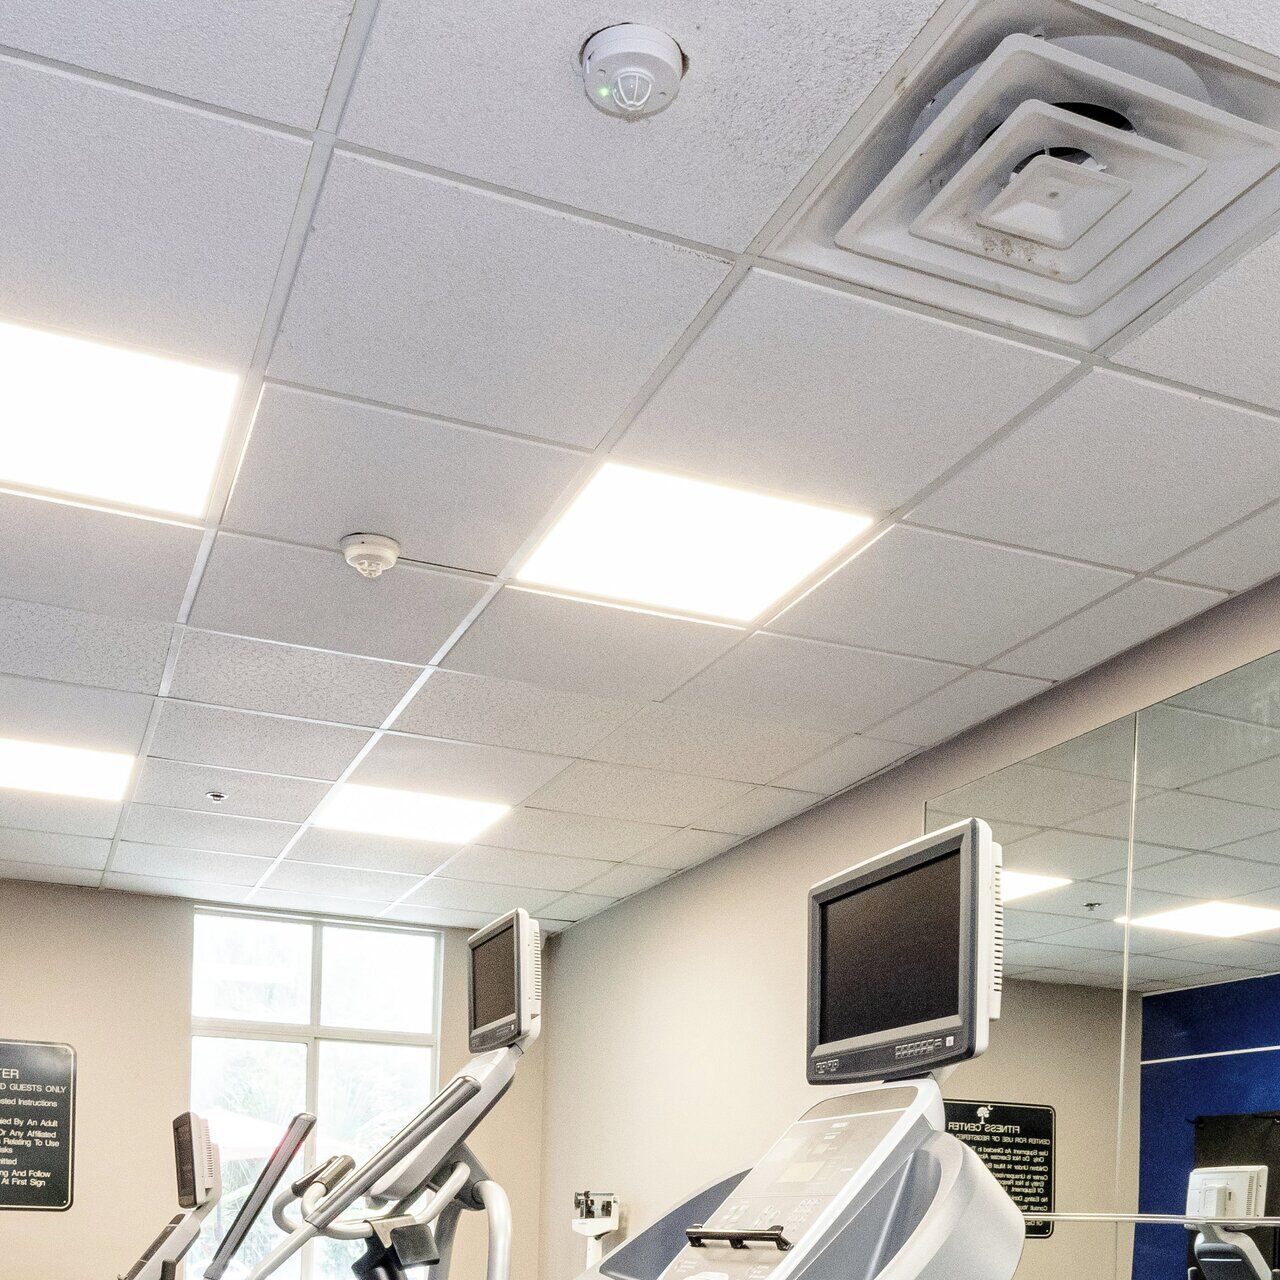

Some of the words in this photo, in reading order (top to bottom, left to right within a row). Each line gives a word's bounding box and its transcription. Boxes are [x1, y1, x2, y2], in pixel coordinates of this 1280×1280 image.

[10, 1084, 42, 1092] GUESTS
[19, 1098, 58, 1107] Instructions
[14, 1118, 23, 1126] By
[10, 1130, 24, 1138] Any
[27, 1130, 56, 1138] Affiliated
[4, 1138, 32, 1147] Relating
[30, 1179, 46, 1187] Sign
